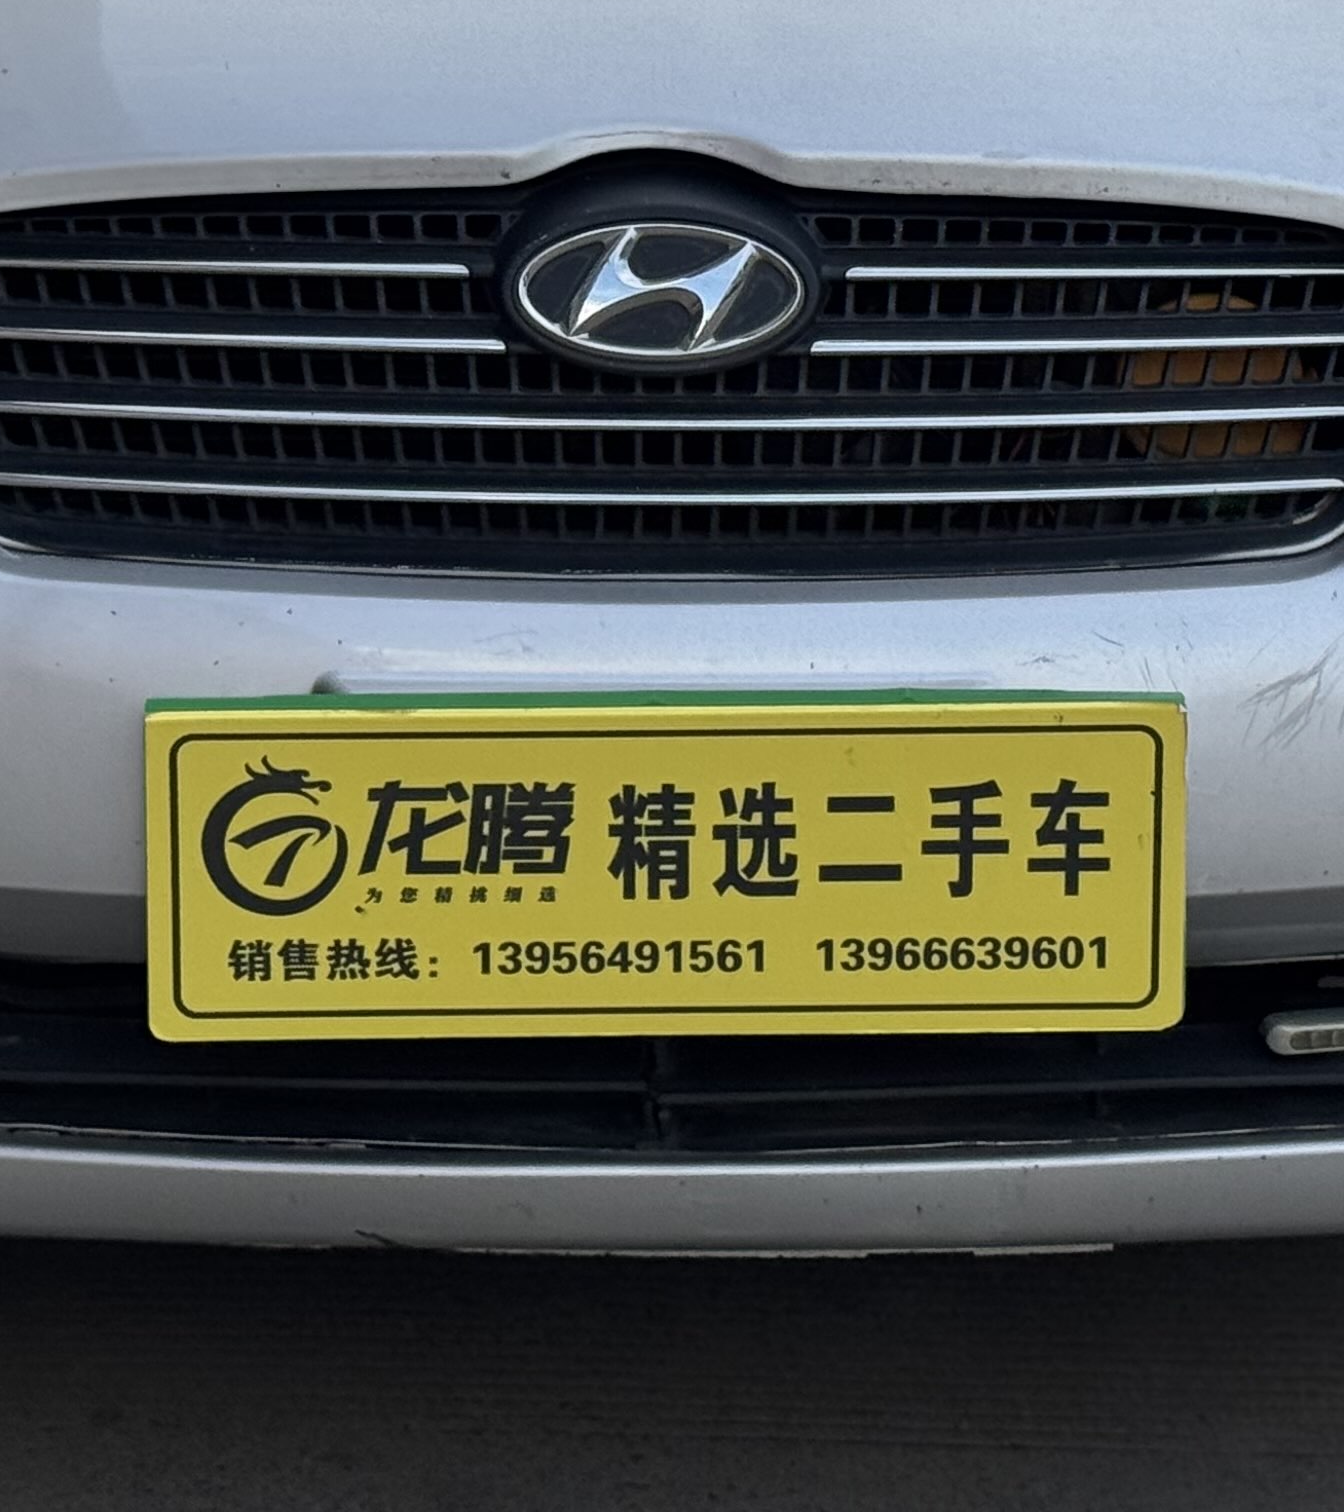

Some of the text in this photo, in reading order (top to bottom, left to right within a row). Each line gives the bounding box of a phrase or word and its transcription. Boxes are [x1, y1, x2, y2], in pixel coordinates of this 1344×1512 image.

[358, 779, 1111, 900] 龙腾 精选二手车
[473, 940, 764, 975] 13956491561
[816, 936, 1108, 972] 13966639601
